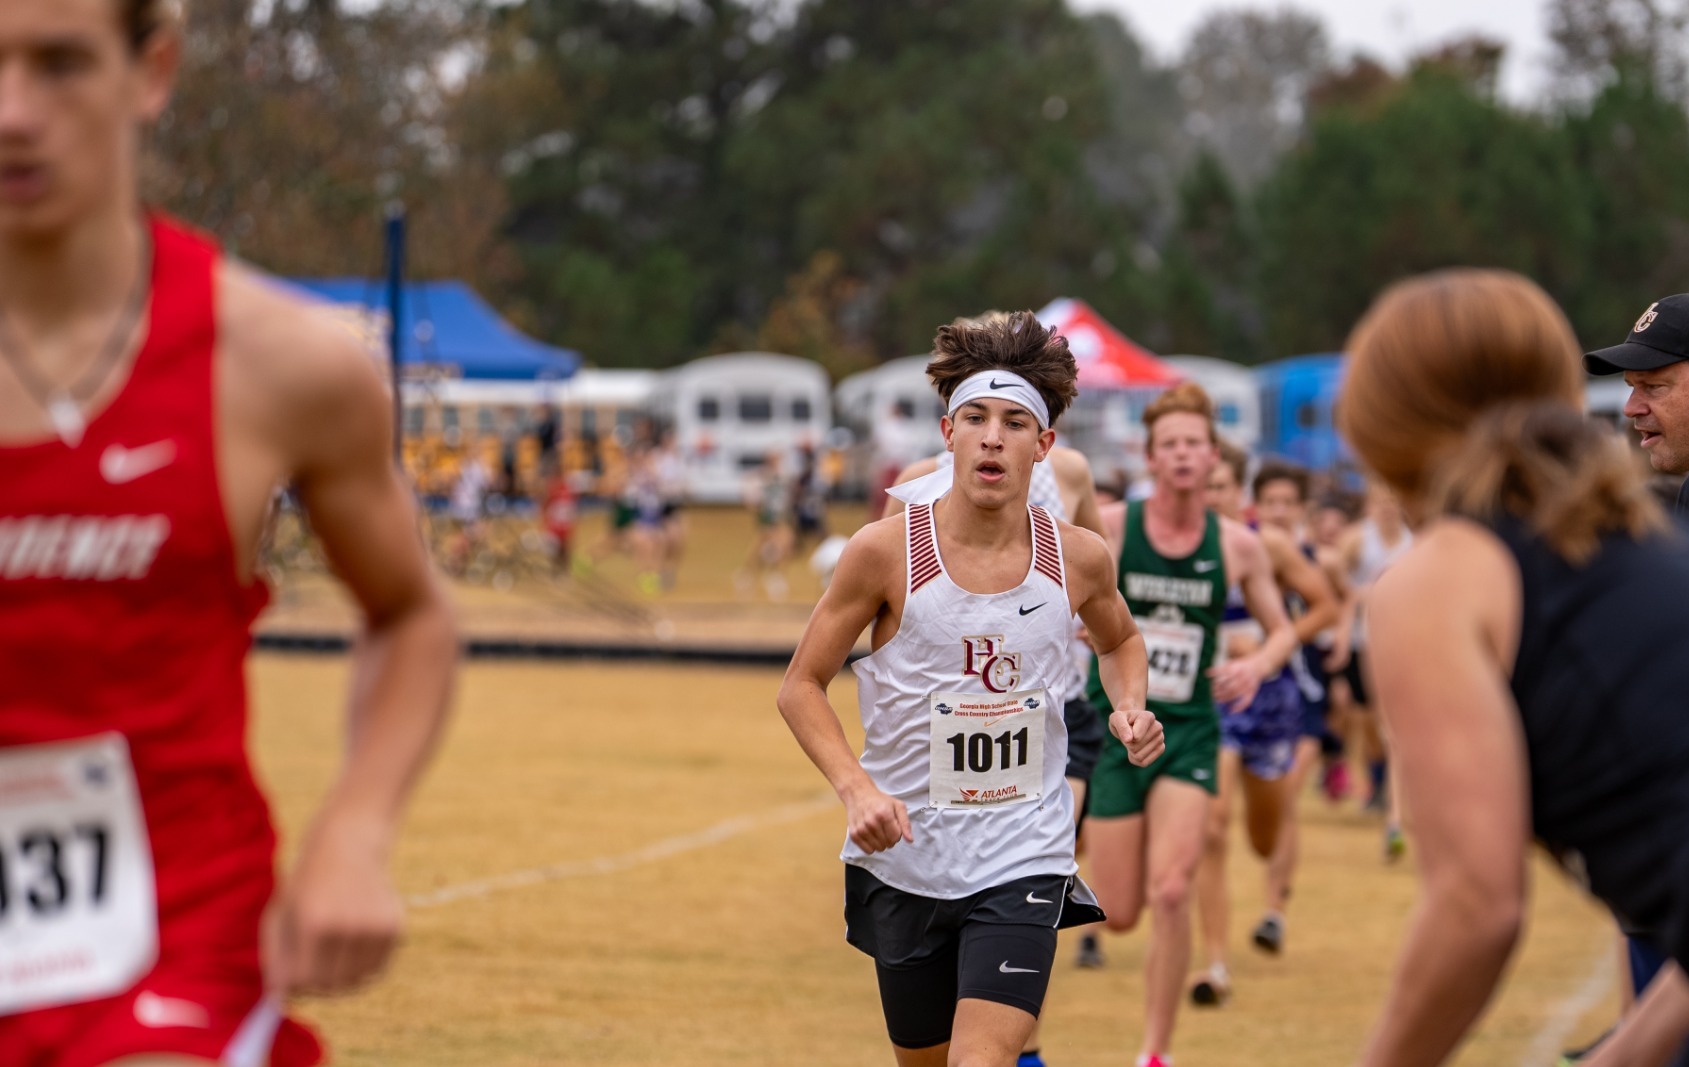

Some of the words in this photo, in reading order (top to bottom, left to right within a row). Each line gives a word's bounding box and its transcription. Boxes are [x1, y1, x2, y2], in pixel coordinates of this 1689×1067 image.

[946, 726, 1028, 773] 1011
[981, 785, 1017, 799] ATLANTA
[0, 820, 108, 916] 37
